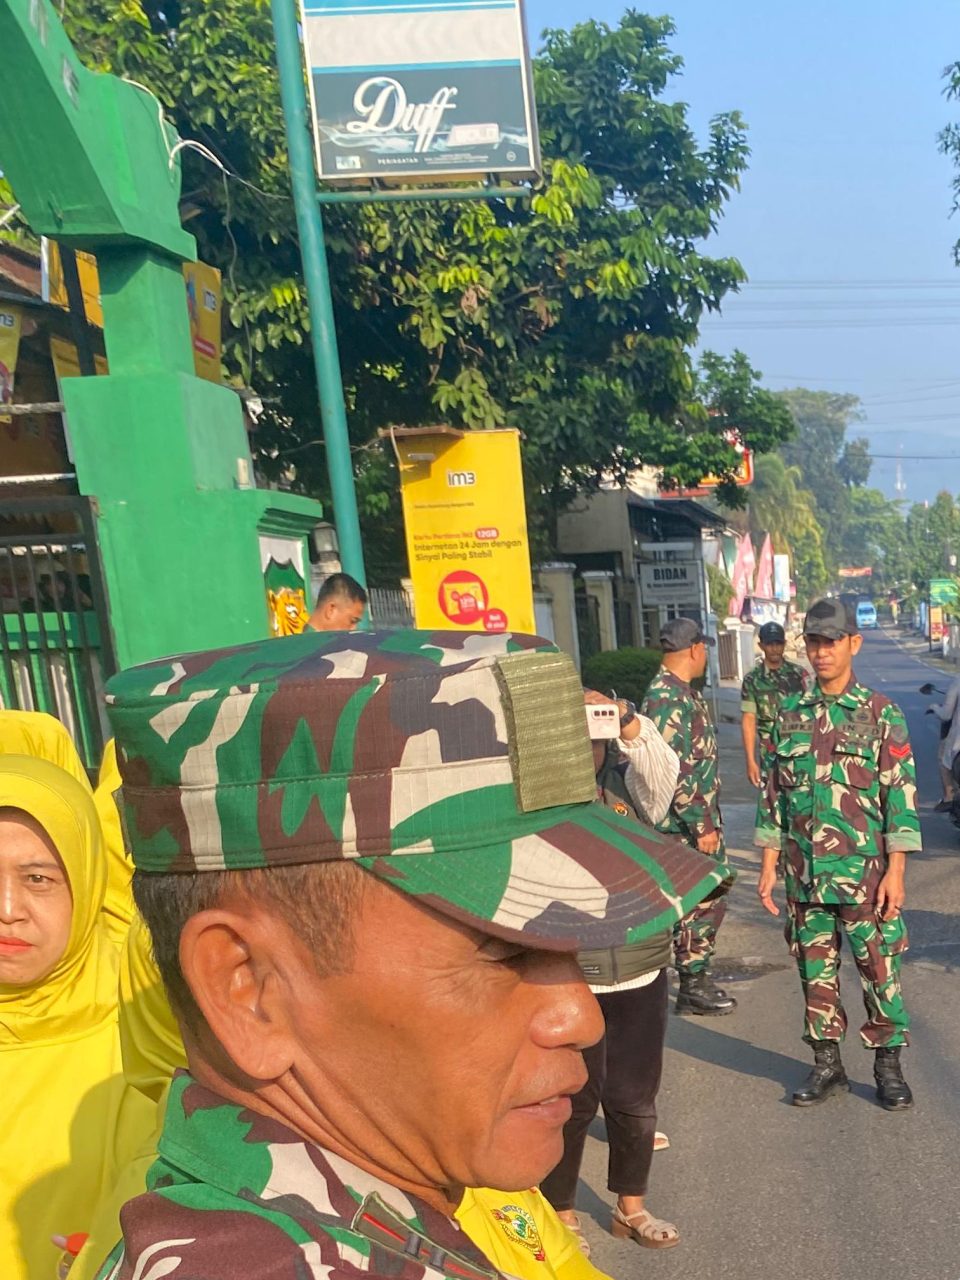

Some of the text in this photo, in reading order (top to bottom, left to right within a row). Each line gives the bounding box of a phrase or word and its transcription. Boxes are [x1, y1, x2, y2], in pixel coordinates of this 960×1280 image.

[346, 76, 458, 153] Duff
[447, 470, 476, 487] im3
[414, 539, 522, 551] Internetan 24 Jam dengan
[653, 567, 688, 580] BIDAN
